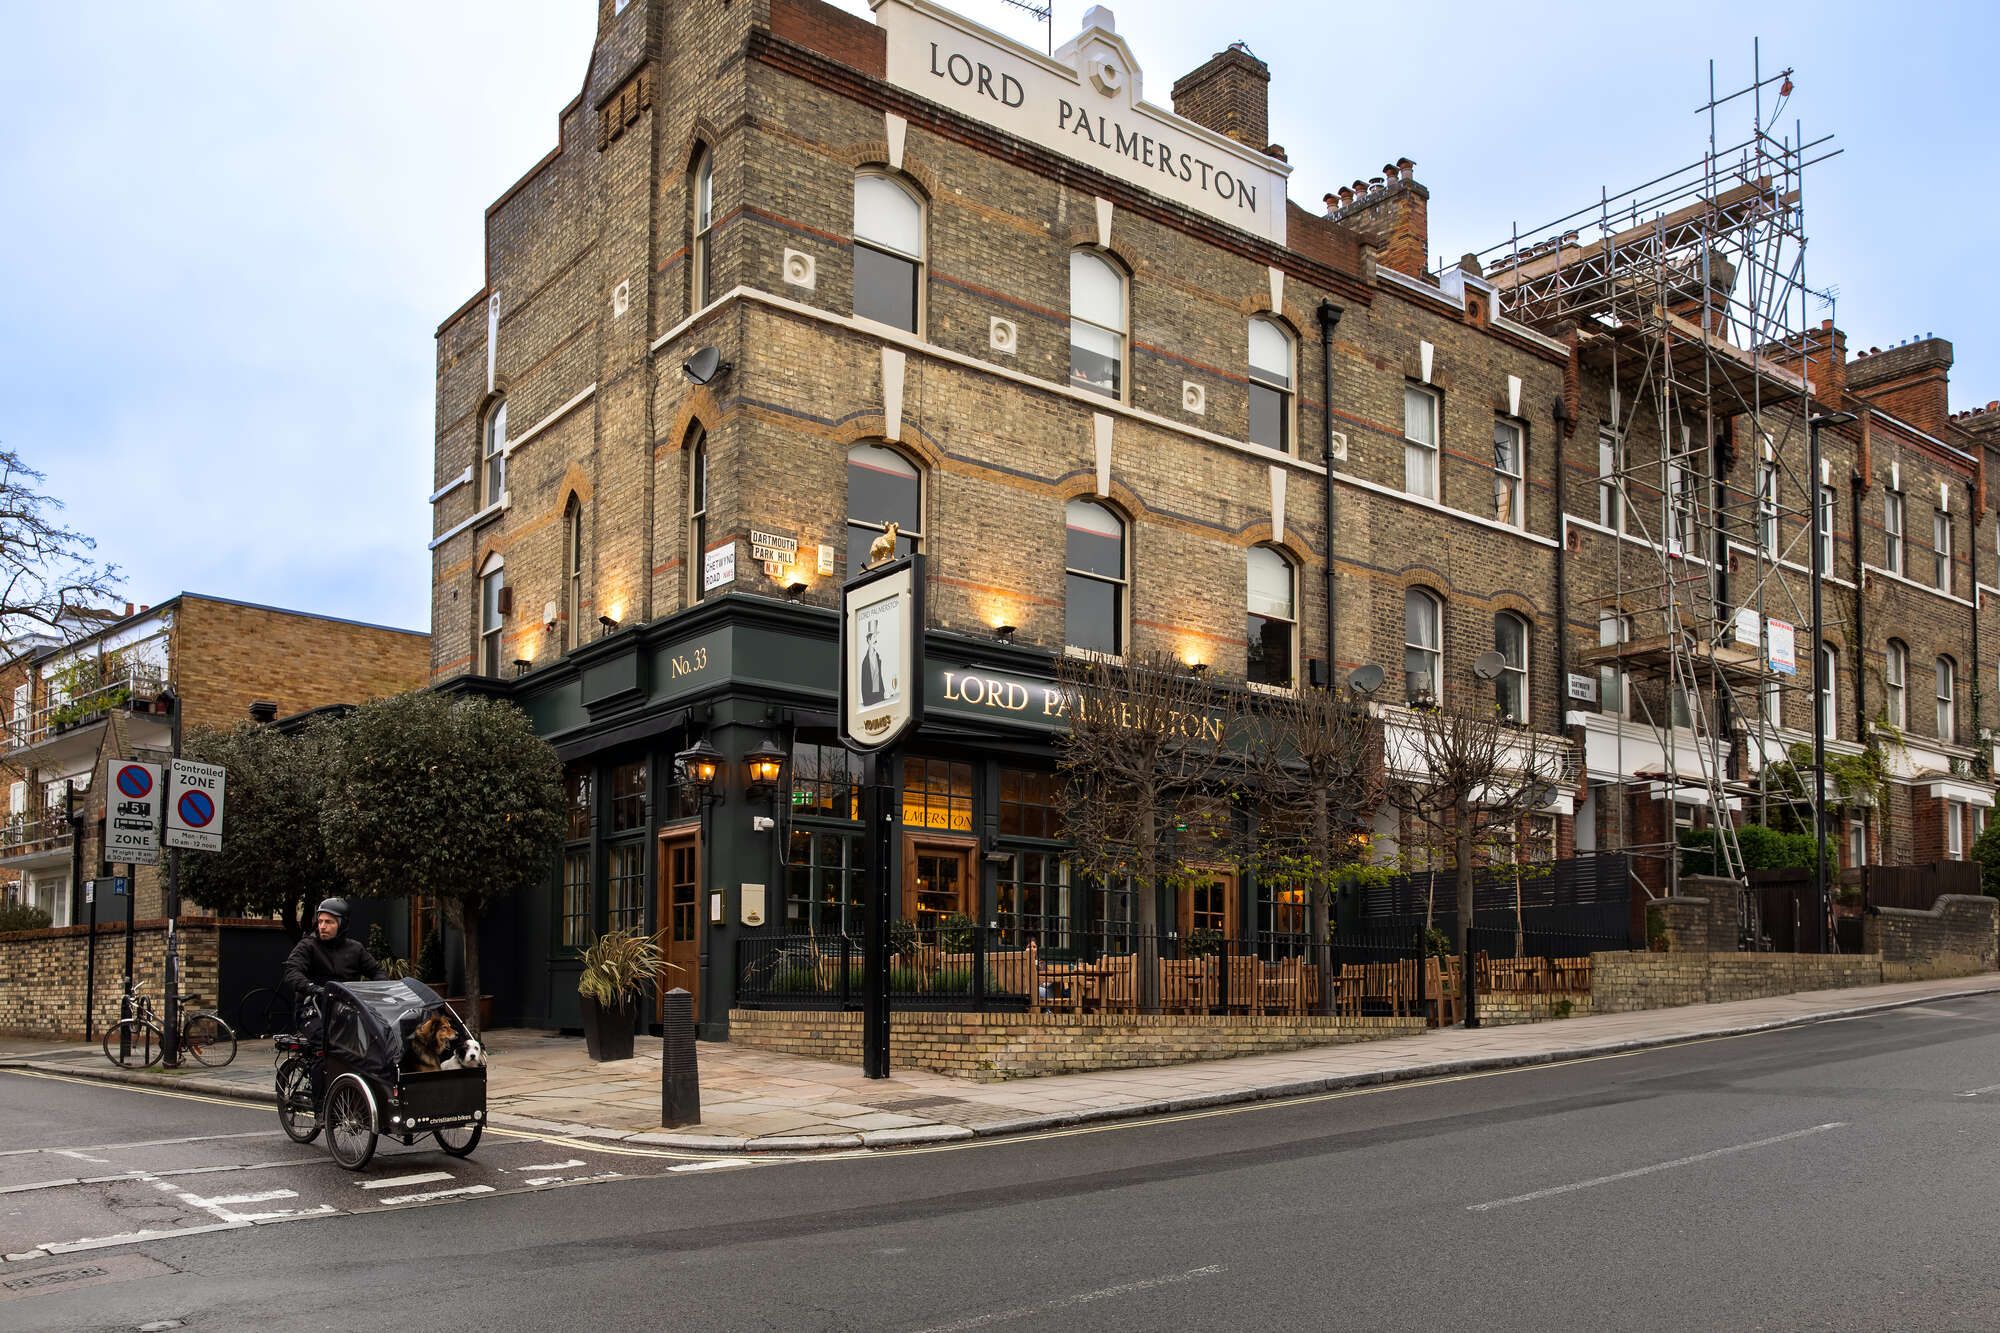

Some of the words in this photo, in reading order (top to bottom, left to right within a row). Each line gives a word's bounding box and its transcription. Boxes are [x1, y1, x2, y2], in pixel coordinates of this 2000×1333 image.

[929, 42, 1025, 108] LORD
[1058, 99, 1257, 213] PALMERSTON
[752, 532, 795, 550] DARTMOUTH
[706, 553, 734, 573] CHETWYND
[755, 547, 774, 560] PARK
[777, 551, 793, 564] HILL
[706, 572, 720, 585] ROAD
[672, 656, 692, 679] No.
[694, 647, 707, 671] 33
[943, 671, 1030, 711] LORD
[173, 762, 224, 777] Controlled
[180, 774, 215, 789] ZONE
[115, 834, 150, 845] ZONE
